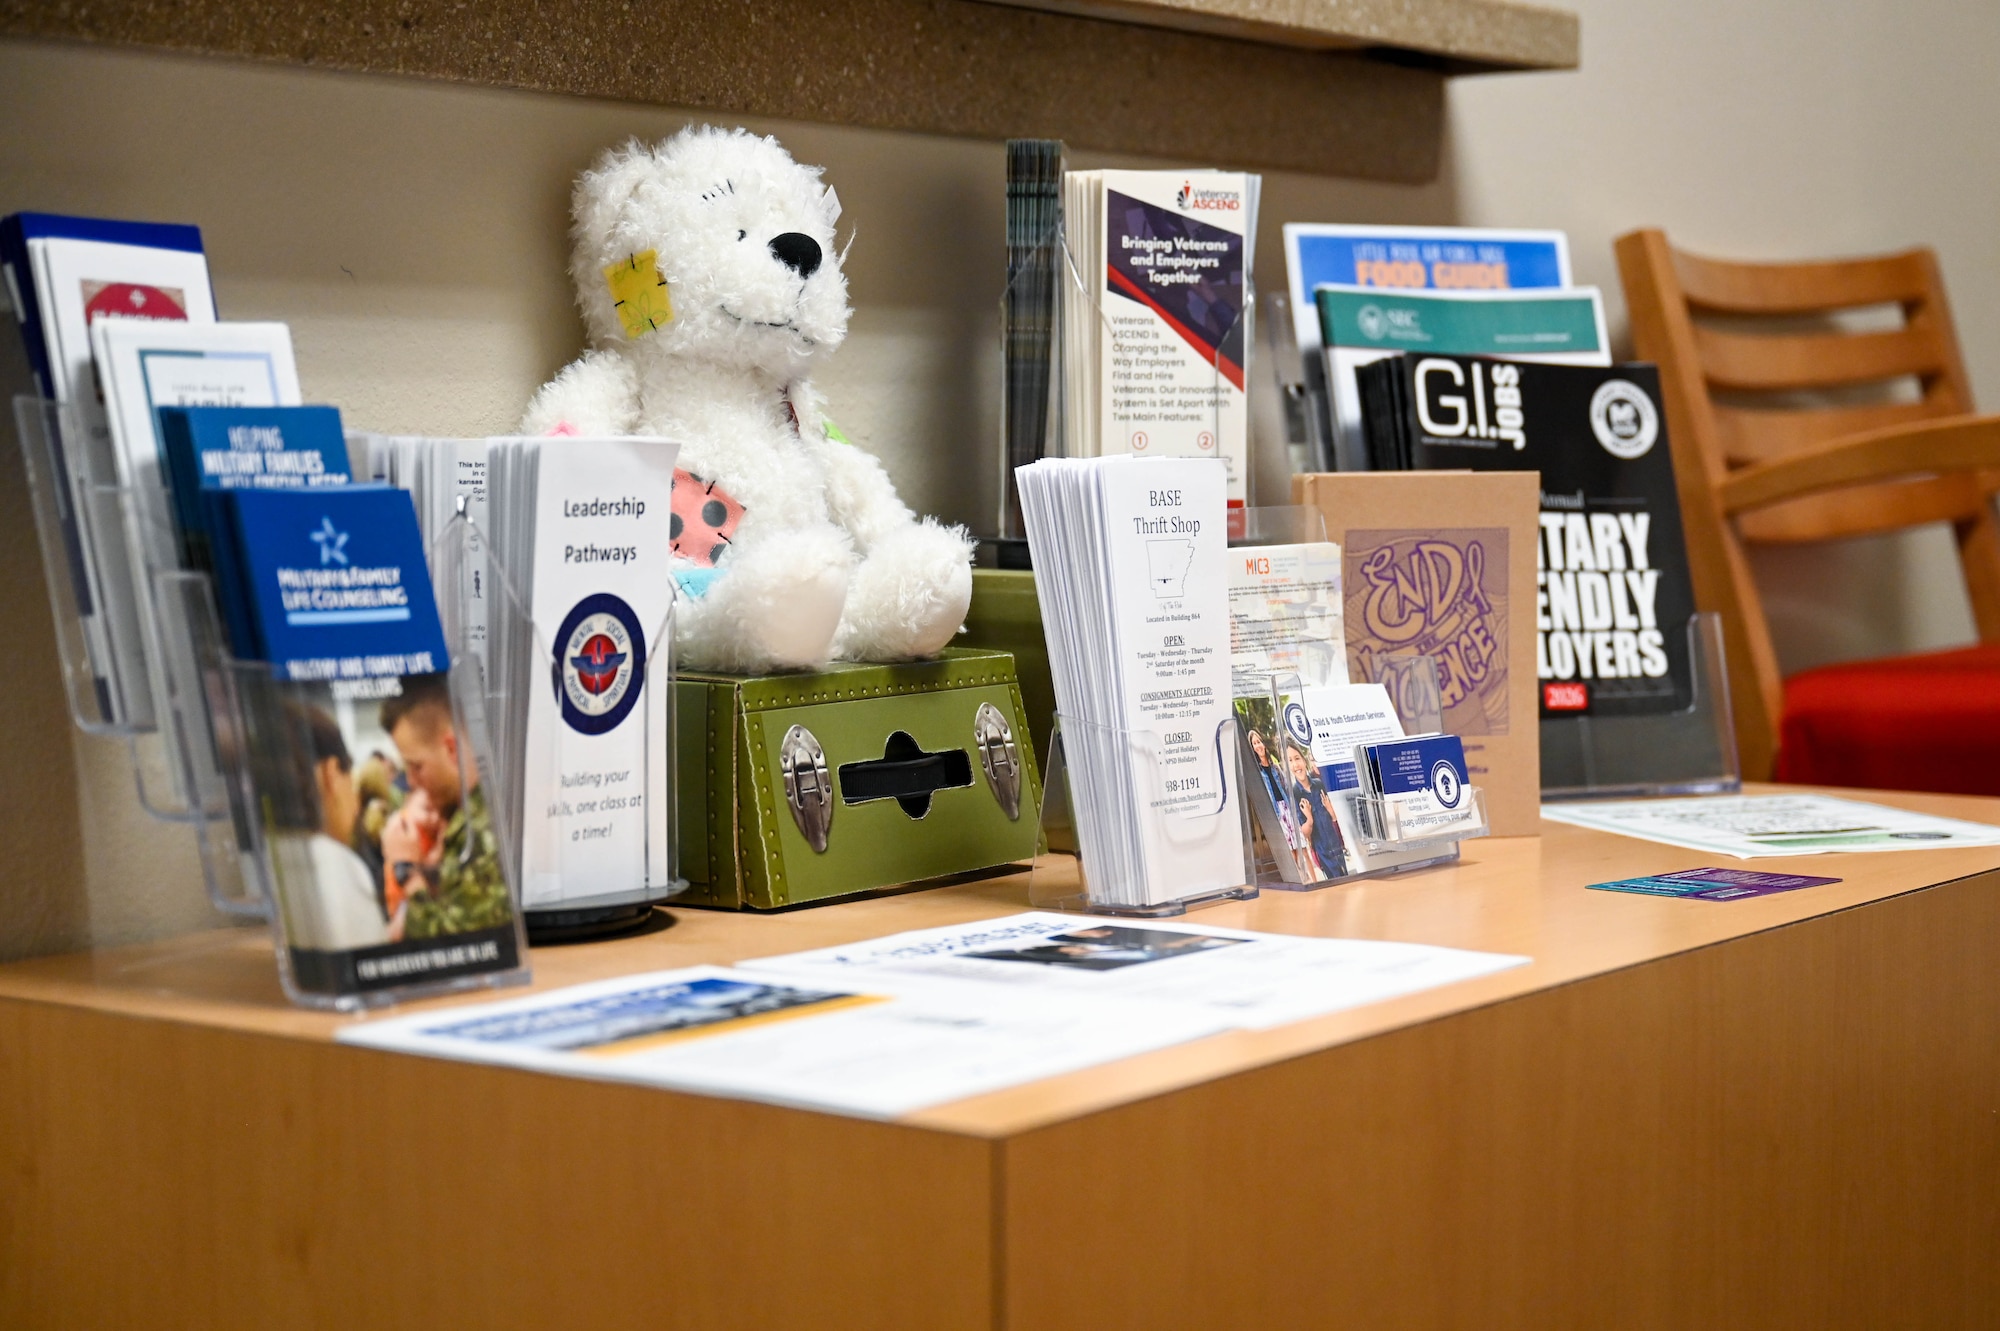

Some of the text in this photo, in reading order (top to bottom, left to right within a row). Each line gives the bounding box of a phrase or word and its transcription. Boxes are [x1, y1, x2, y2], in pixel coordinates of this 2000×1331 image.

[1193, 189, 1239, 199] Veterans
[1193, 199, 1239, 210] ASCEND
[1121, 235, 1228, 253] Bringing Veterans
[1130, 253, 1219, 270] and Employers
[1147, 269, 1201, 286] Together
[1356, 260, 1510, 289] FOOD GUIDE
[1112, 316, 1154, 325] Veterans
[1152, 330, 1159, 339] is
[1161, 344, 1177, 353] the
[1112, 357, 1185, 368] Way Employers
[1113, 371, 1174, 380] Find and Hire
[1160, 385, 1177, 394] Our
[1150, 399, 1157, 408] is
[1160, 399, 1174, 408] Set
[1176, 399, 1204, 410] Apart
[1414, 358, 1499, 438] G.I.
[1491, 364, 1526, 450] JOBS
[1133, 412, 1156, 421] Main
[1159, 412, 1203, 421] Features:
[1149, 490, 1182, 507] BASE
[564, 496, 645, 519] Leadership
[1133, 515, 1200, 537] Thrift Shop
[1537, 512, 1650, 570] TARY
[564, 542, 636, 565] Pathways
[1245, 557, 1270, 575] MIC3
[311, 586, 408, 611] COUNSELING
[1361, 540, 1465, 643] END
[1171, 614, 1191, 622] Building
[1163, 635, 1186, 647] OPEN:
[1137, 652, 1156, 660] Tuesday
[1160, 649, 1187, 657] Wednesday
[1191, 646, 1214, 655] Thursday
[1155, 660, 1175, 668] Saturday
[1190, 657, 1205, 665] month
[1140, 686, 1213, 701] CONSIGNMENTS ACCEPTED:
[1163, 701, 1188, 709] Wednesday
[1193, 698, 1215, 706] Thursday
[1313, 718, 1326, 727] Child
[1331, 715, 1344, 724] Youth
[1345, 713, 1366, 723] Education
[1366, 711, 1386, 720] Services
[1164, 731, 1193, 745] CLOSED:
[1164, 745, 1200, 756] ederal Holidays
[1178, 756, 1197, 764] Holidays
[604, 769, 631, 786] your
[576, 801, 598, 814] one
[600, 795, 627, 811] class
[629, 794, 643, 807] at
[1414, 816, 1437, 827] Education
[1438, 815, 1450, 824] Youth
[1450, 814, 1459, 822] and
[572, 822, 613, 841] a time!
